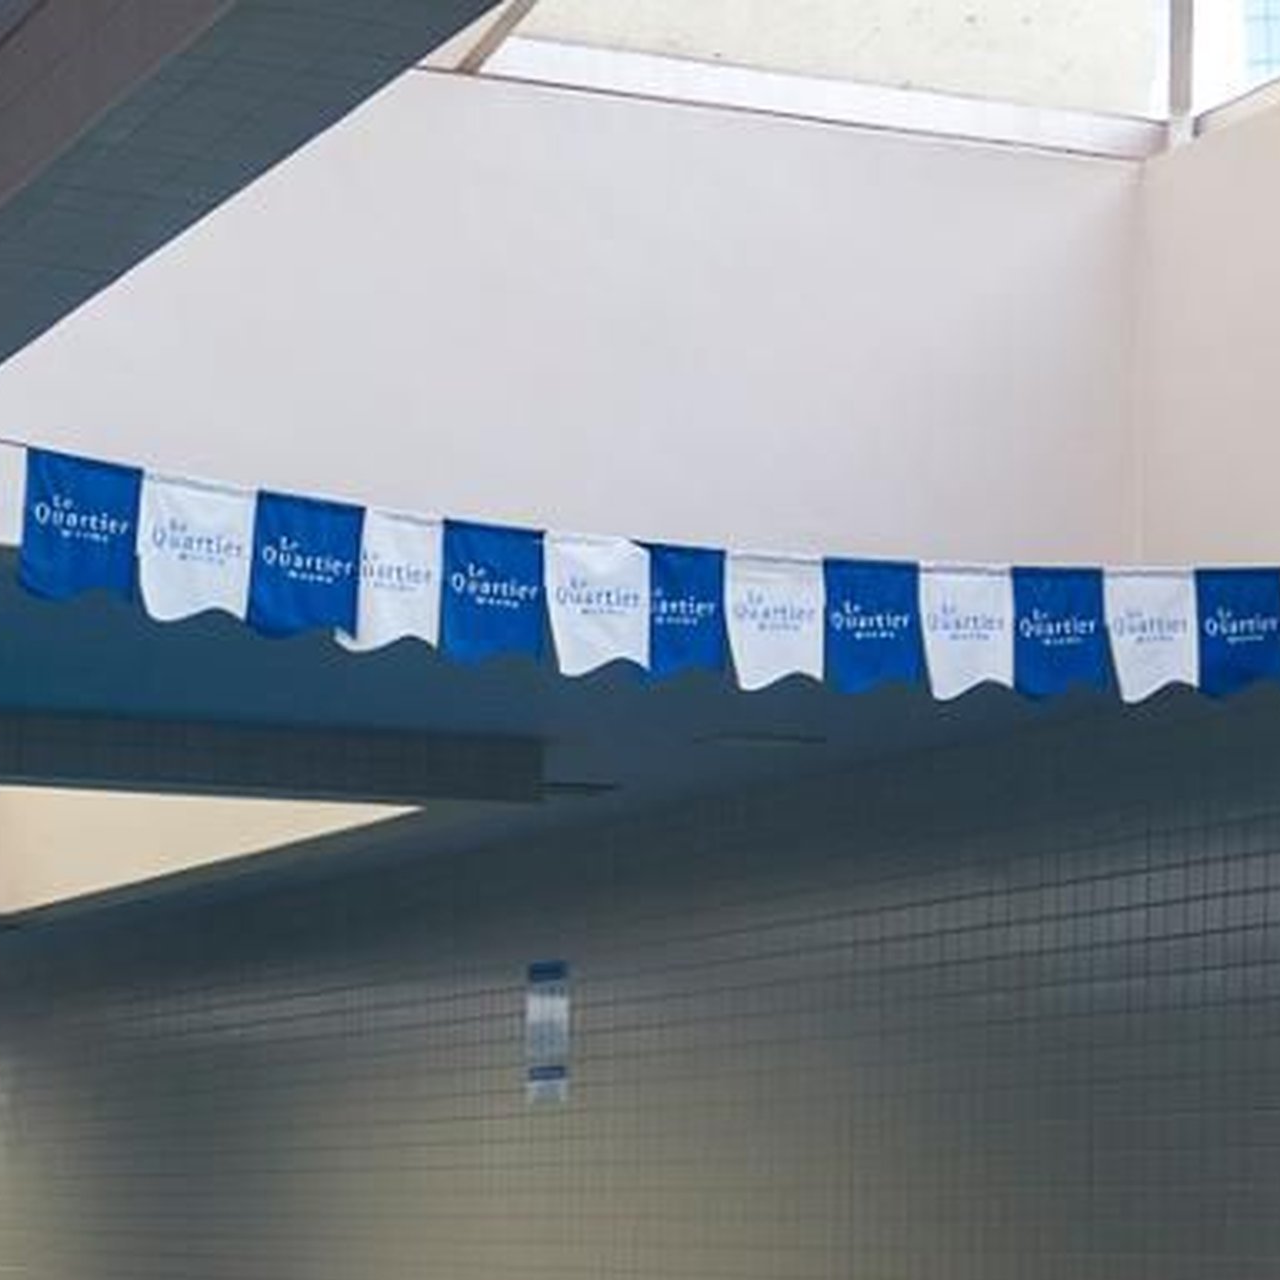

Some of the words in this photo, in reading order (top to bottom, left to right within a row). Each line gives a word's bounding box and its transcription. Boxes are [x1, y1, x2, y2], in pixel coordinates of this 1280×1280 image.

[52, 494, 73, 510] Le
[35, 502, 129, 534] Quartier
[152, 528, 242, 557] Quartier
[280, 535, 300, 551] Le
[261, 545, 352, 576] Quartier
[468, 561, 487, 577] Le
[451, 572, 539, 600] Quartier
[555, 585, 640, 607] Quartier
[733, 603, 816, 622] Quartier
[831, 611, 910, 631] Quartier
[926, 612, 1006, 633] Quartier
[1019, 617, 1096, 638] Quartier
[1113, 618, 1188, 638] Quartier
[1204, 618, 1279, 637] Quartier
